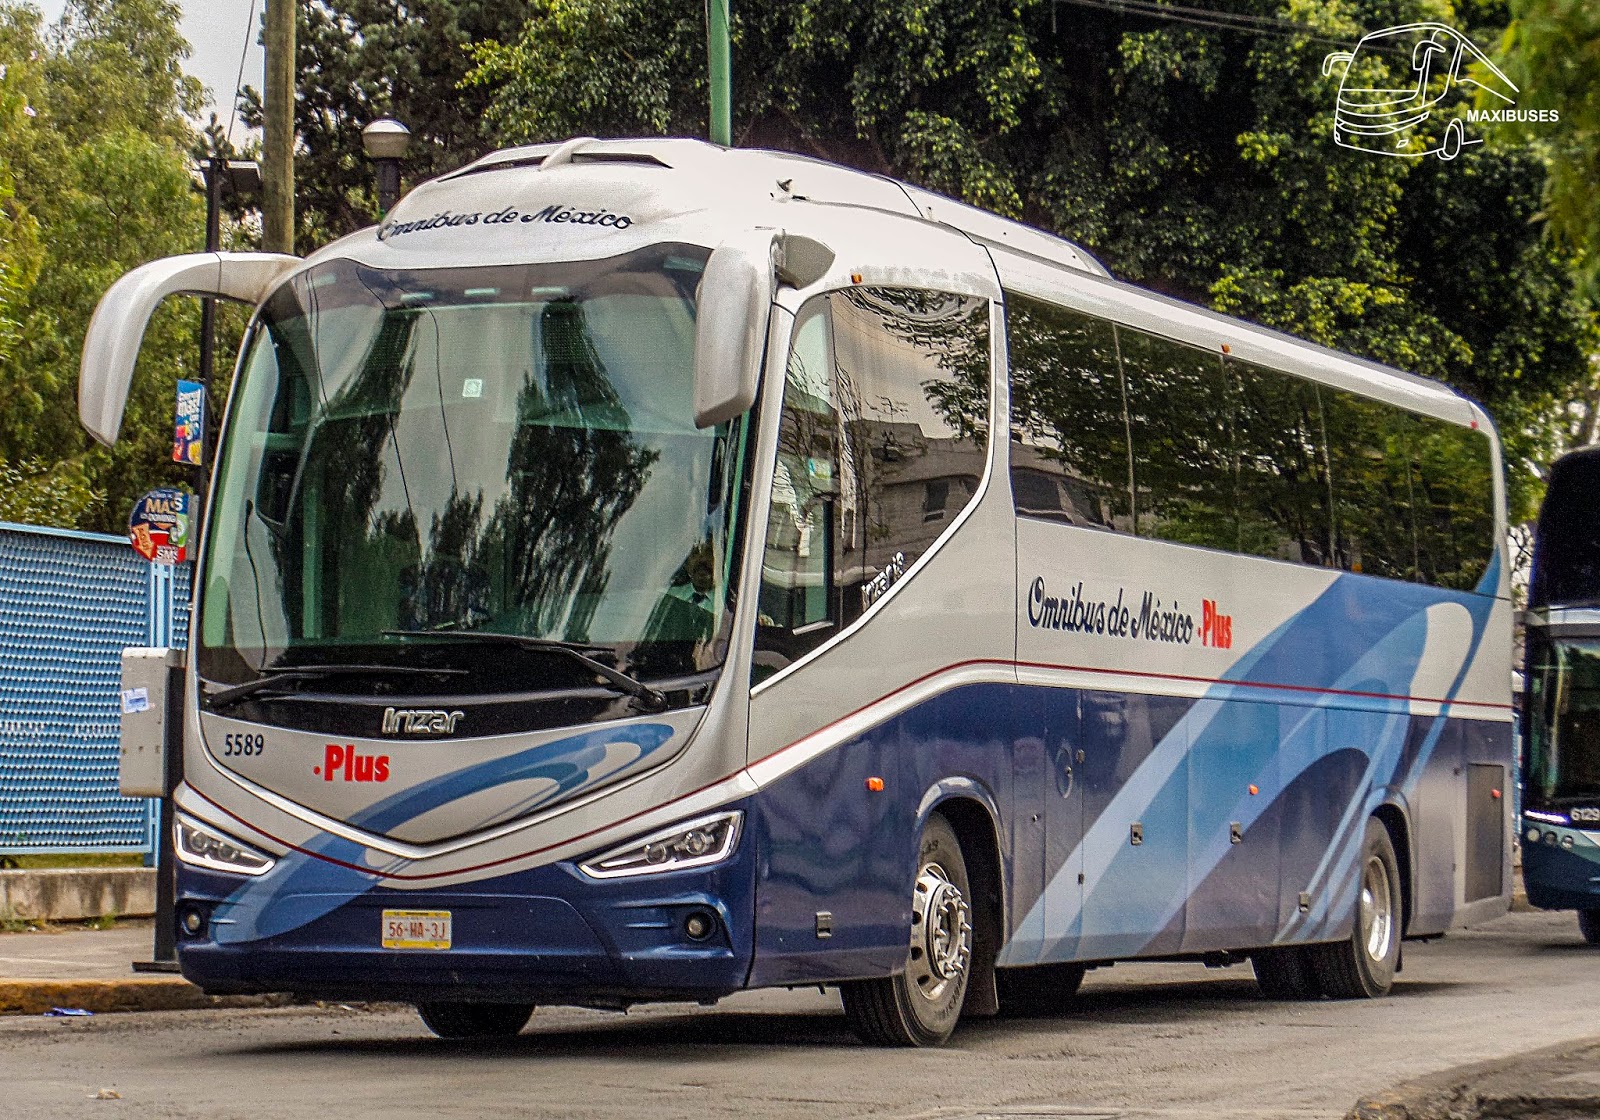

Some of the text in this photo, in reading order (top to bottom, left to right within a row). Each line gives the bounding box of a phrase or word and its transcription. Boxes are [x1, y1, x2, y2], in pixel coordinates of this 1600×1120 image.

[376, 204, 634, 241] Omnibus de México
[1028, 576, 1105, 634] Omnibus
[1107, 587, 1129, 637] de
[1131, 590, 1193, 644] México
[381, 707, 464, 734] Irizar
[224, 733, 264, 756] 5589
